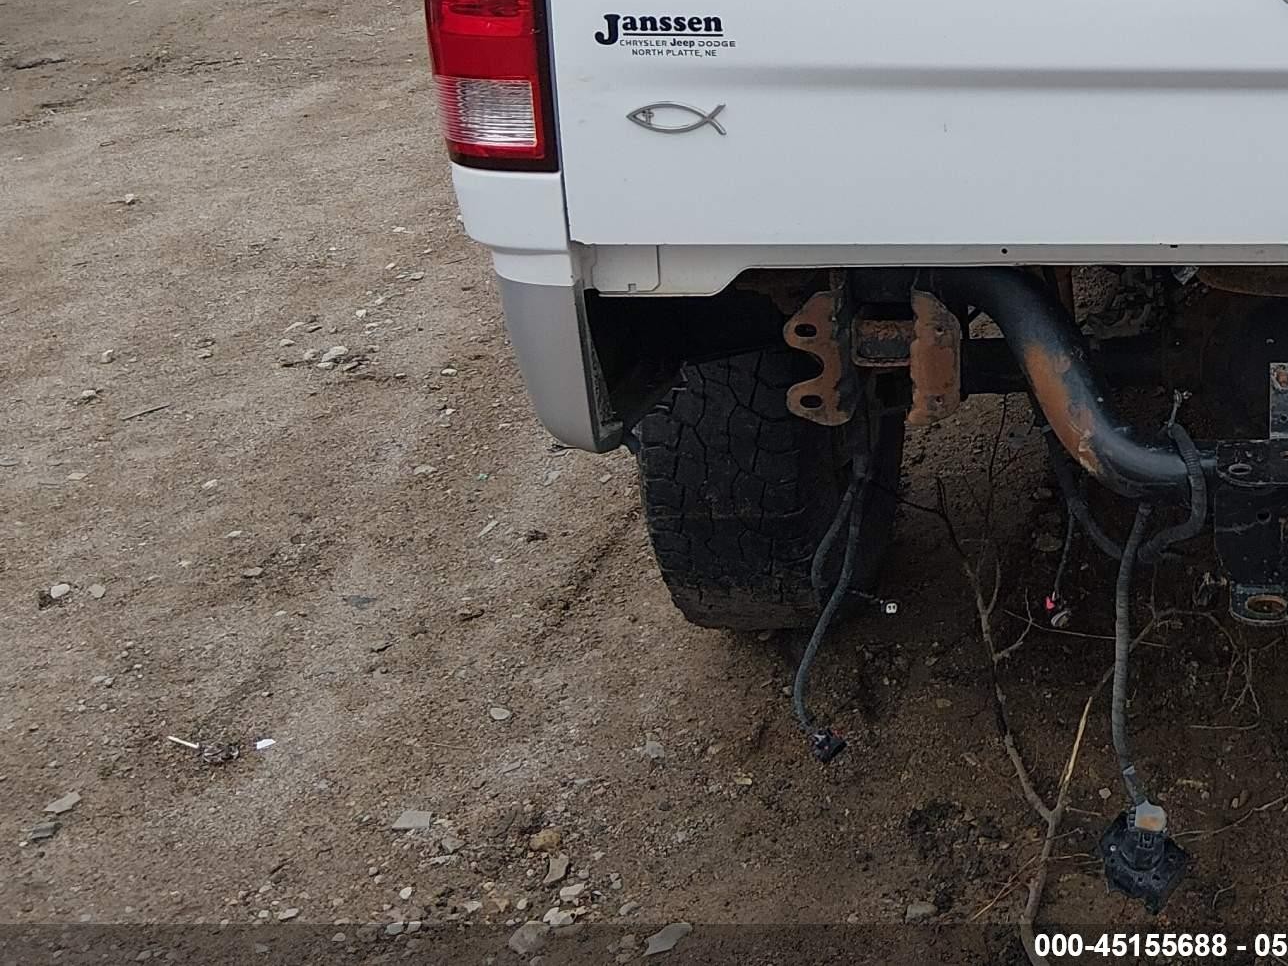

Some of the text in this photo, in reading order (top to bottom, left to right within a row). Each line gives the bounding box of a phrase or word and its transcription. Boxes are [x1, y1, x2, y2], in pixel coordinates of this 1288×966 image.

[594, 14, 723, 45] Janssen
[619, 38, 736, 48] CHRYSLER Jeep DODGE
[632, 48, 717, 57] NORTH PLATTE, NE
